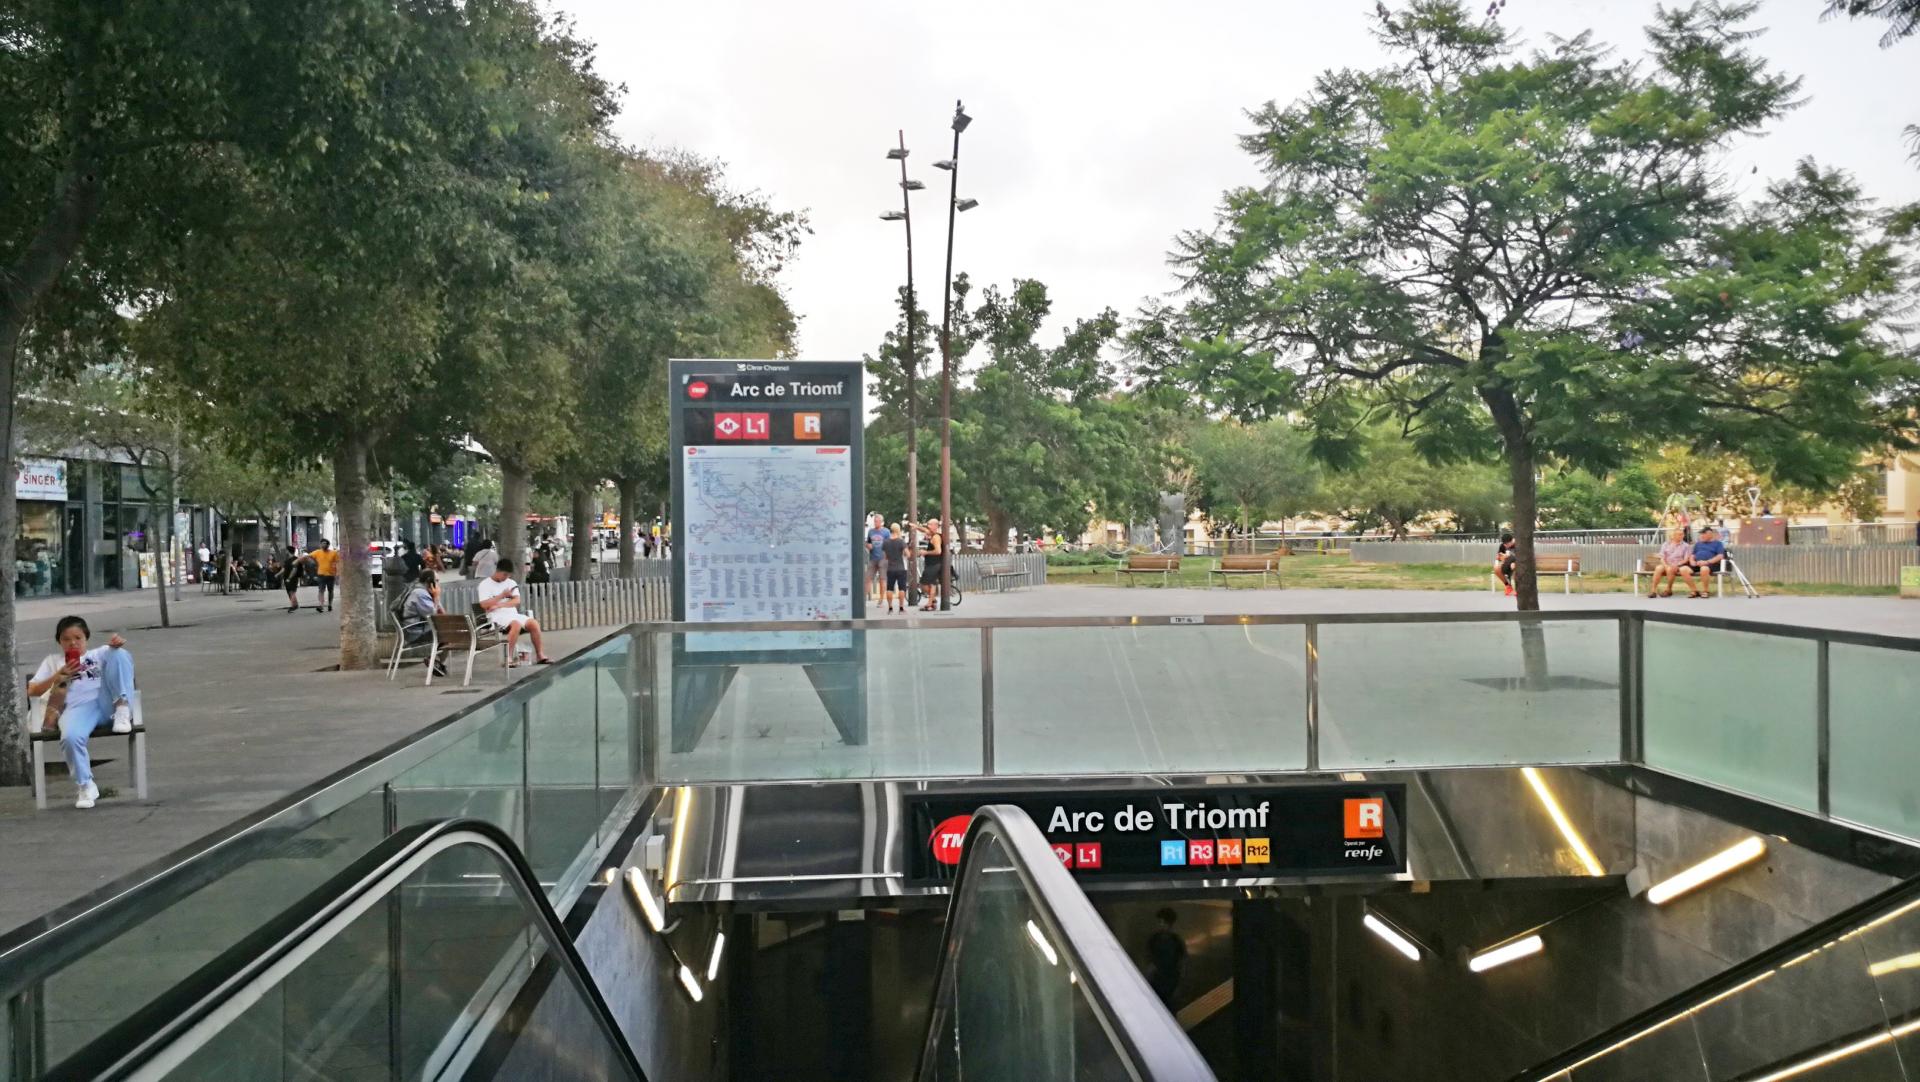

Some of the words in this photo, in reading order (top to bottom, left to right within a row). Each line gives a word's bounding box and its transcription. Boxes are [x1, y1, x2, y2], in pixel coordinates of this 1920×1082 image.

[730, 382, 760, 397] Arc
[764, 382, 785, 396] de
[789, 381, 844, 396] Triomf
[746, 418, 765, 433] L1
[804, 415, 821, 433] R
[23, 474, 56, 486] SINGER
[1047, 805, 1104, 833] Arc
[1114, 804, 1154, 832] de
[1163, 801, 1270, 830] Triomf
[1359, 803, 1383, 828] R
[941, 833, 966, 849] TM
[1079, 848, 1096, 863] L1
[1164, 846, 1184, 860] R1
[1190, 845, 1213, 860] R3
[1217, 844, 1241, 859] R4
[1247, 845, 1269, 856] R12
[1344, 845, 1384, 861] renfe
